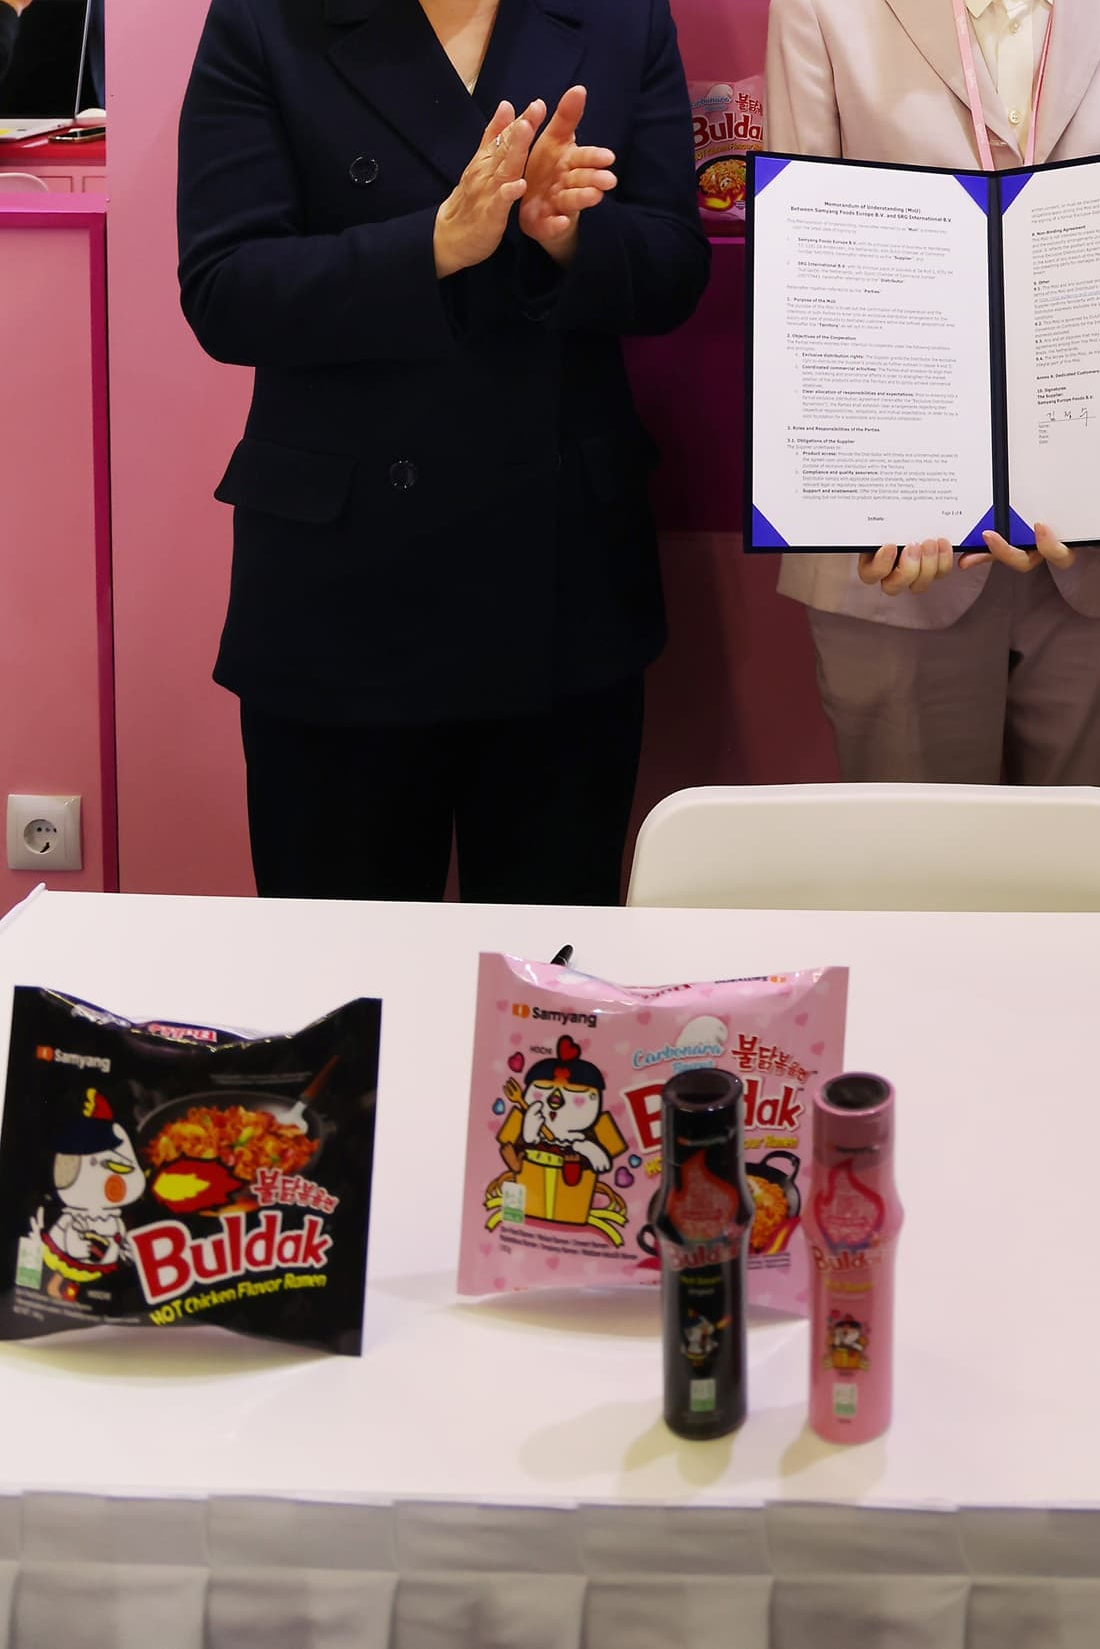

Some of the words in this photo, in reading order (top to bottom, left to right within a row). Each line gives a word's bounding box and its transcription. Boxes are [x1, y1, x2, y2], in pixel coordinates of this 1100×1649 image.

[532, 1005, 598, 1029] Samyang
[54, 1048, 112, 1073] Samyang
[632, 1042, 723, 1069] Carbonara
[130, 1210, 333, 1304] Buldak
[150, 1299, 183, 1325] HOT
[184, 1287, 237, 1314] Chicken
[237, 1277, 283, 1299] Flavor
[283, 1273, 328, 1291] Ramen
